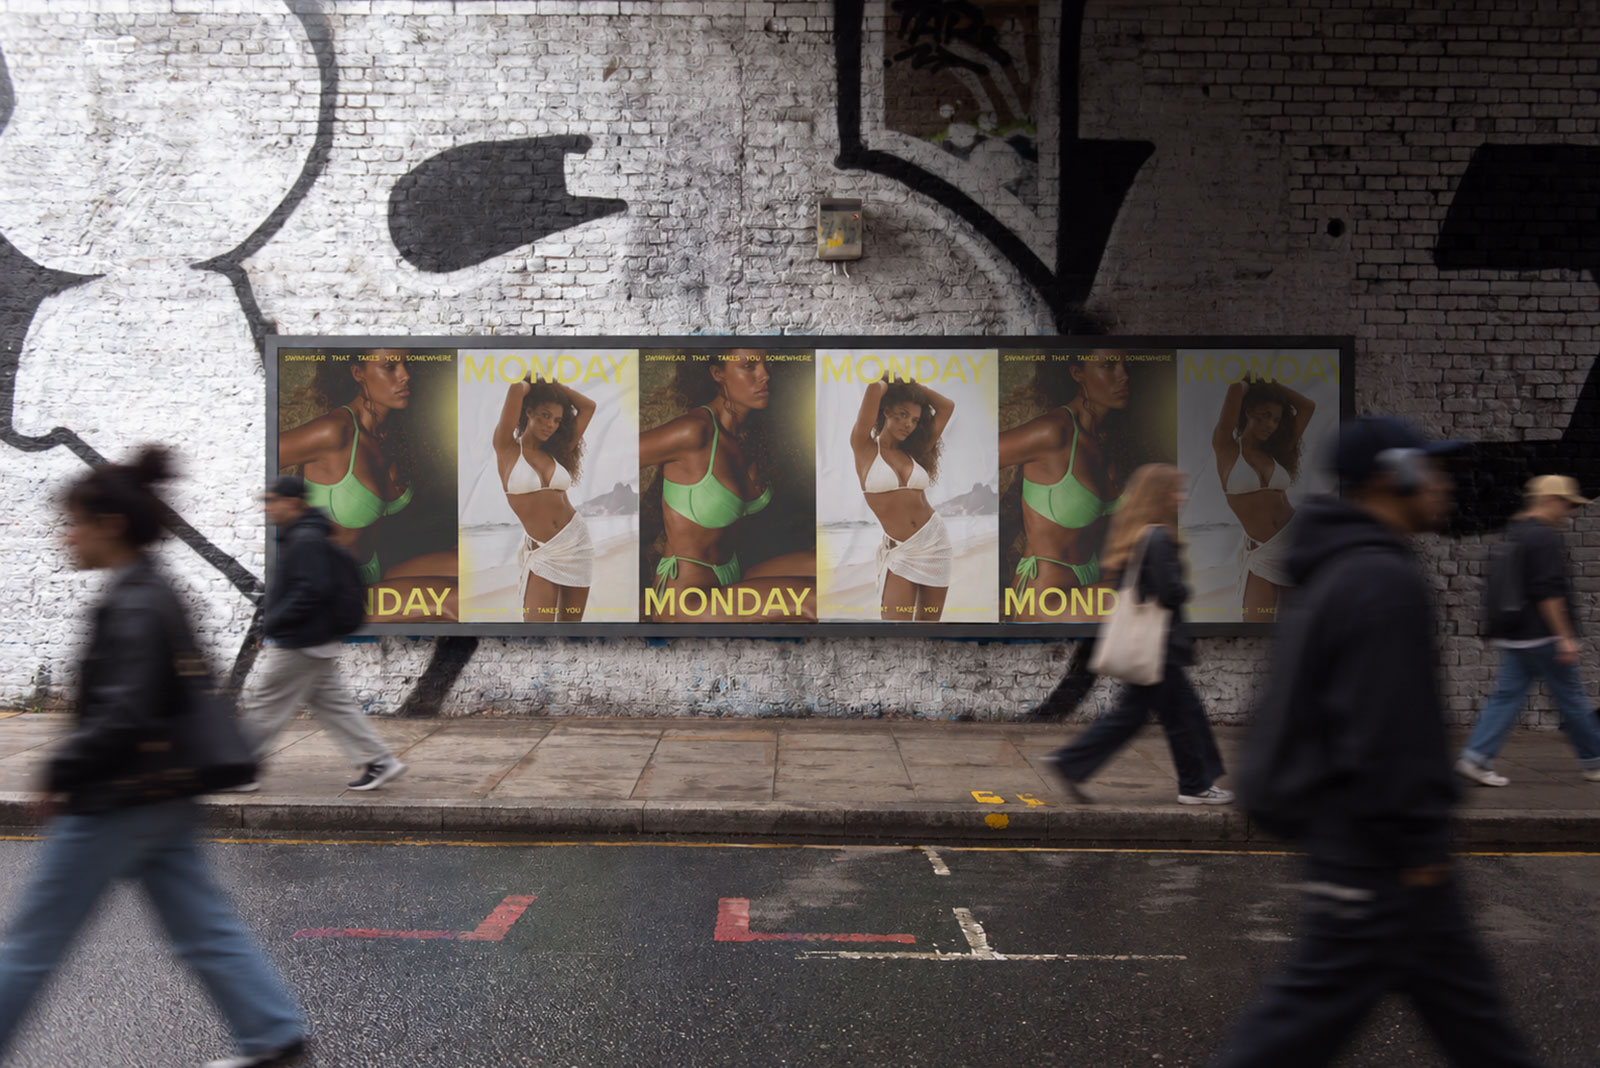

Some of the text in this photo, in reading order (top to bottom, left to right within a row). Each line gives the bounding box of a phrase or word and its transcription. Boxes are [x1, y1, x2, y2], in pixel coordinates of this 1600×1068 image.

[284, 354, 452, 362] SWIMWEAR THAT TAKES YOU SOMEWHERE
[464, 355, 629, 384] MONDAY
[644, 354, 812, 362] SWIMWEAR THAT TAKES YOU SOMEWHERE
[821, 355, 989, 384] MONDAY
[1003, 354, 1172, 362] SWIMWEAR THAT TAKES YOU SOMEWHERE
[1183, 355, 1340, 384] MONDAY
[364, 587, 451, 616] DAY
[644, 587, 811, 616] MONDAY
[1004, 587, 1120, 616] MOND
